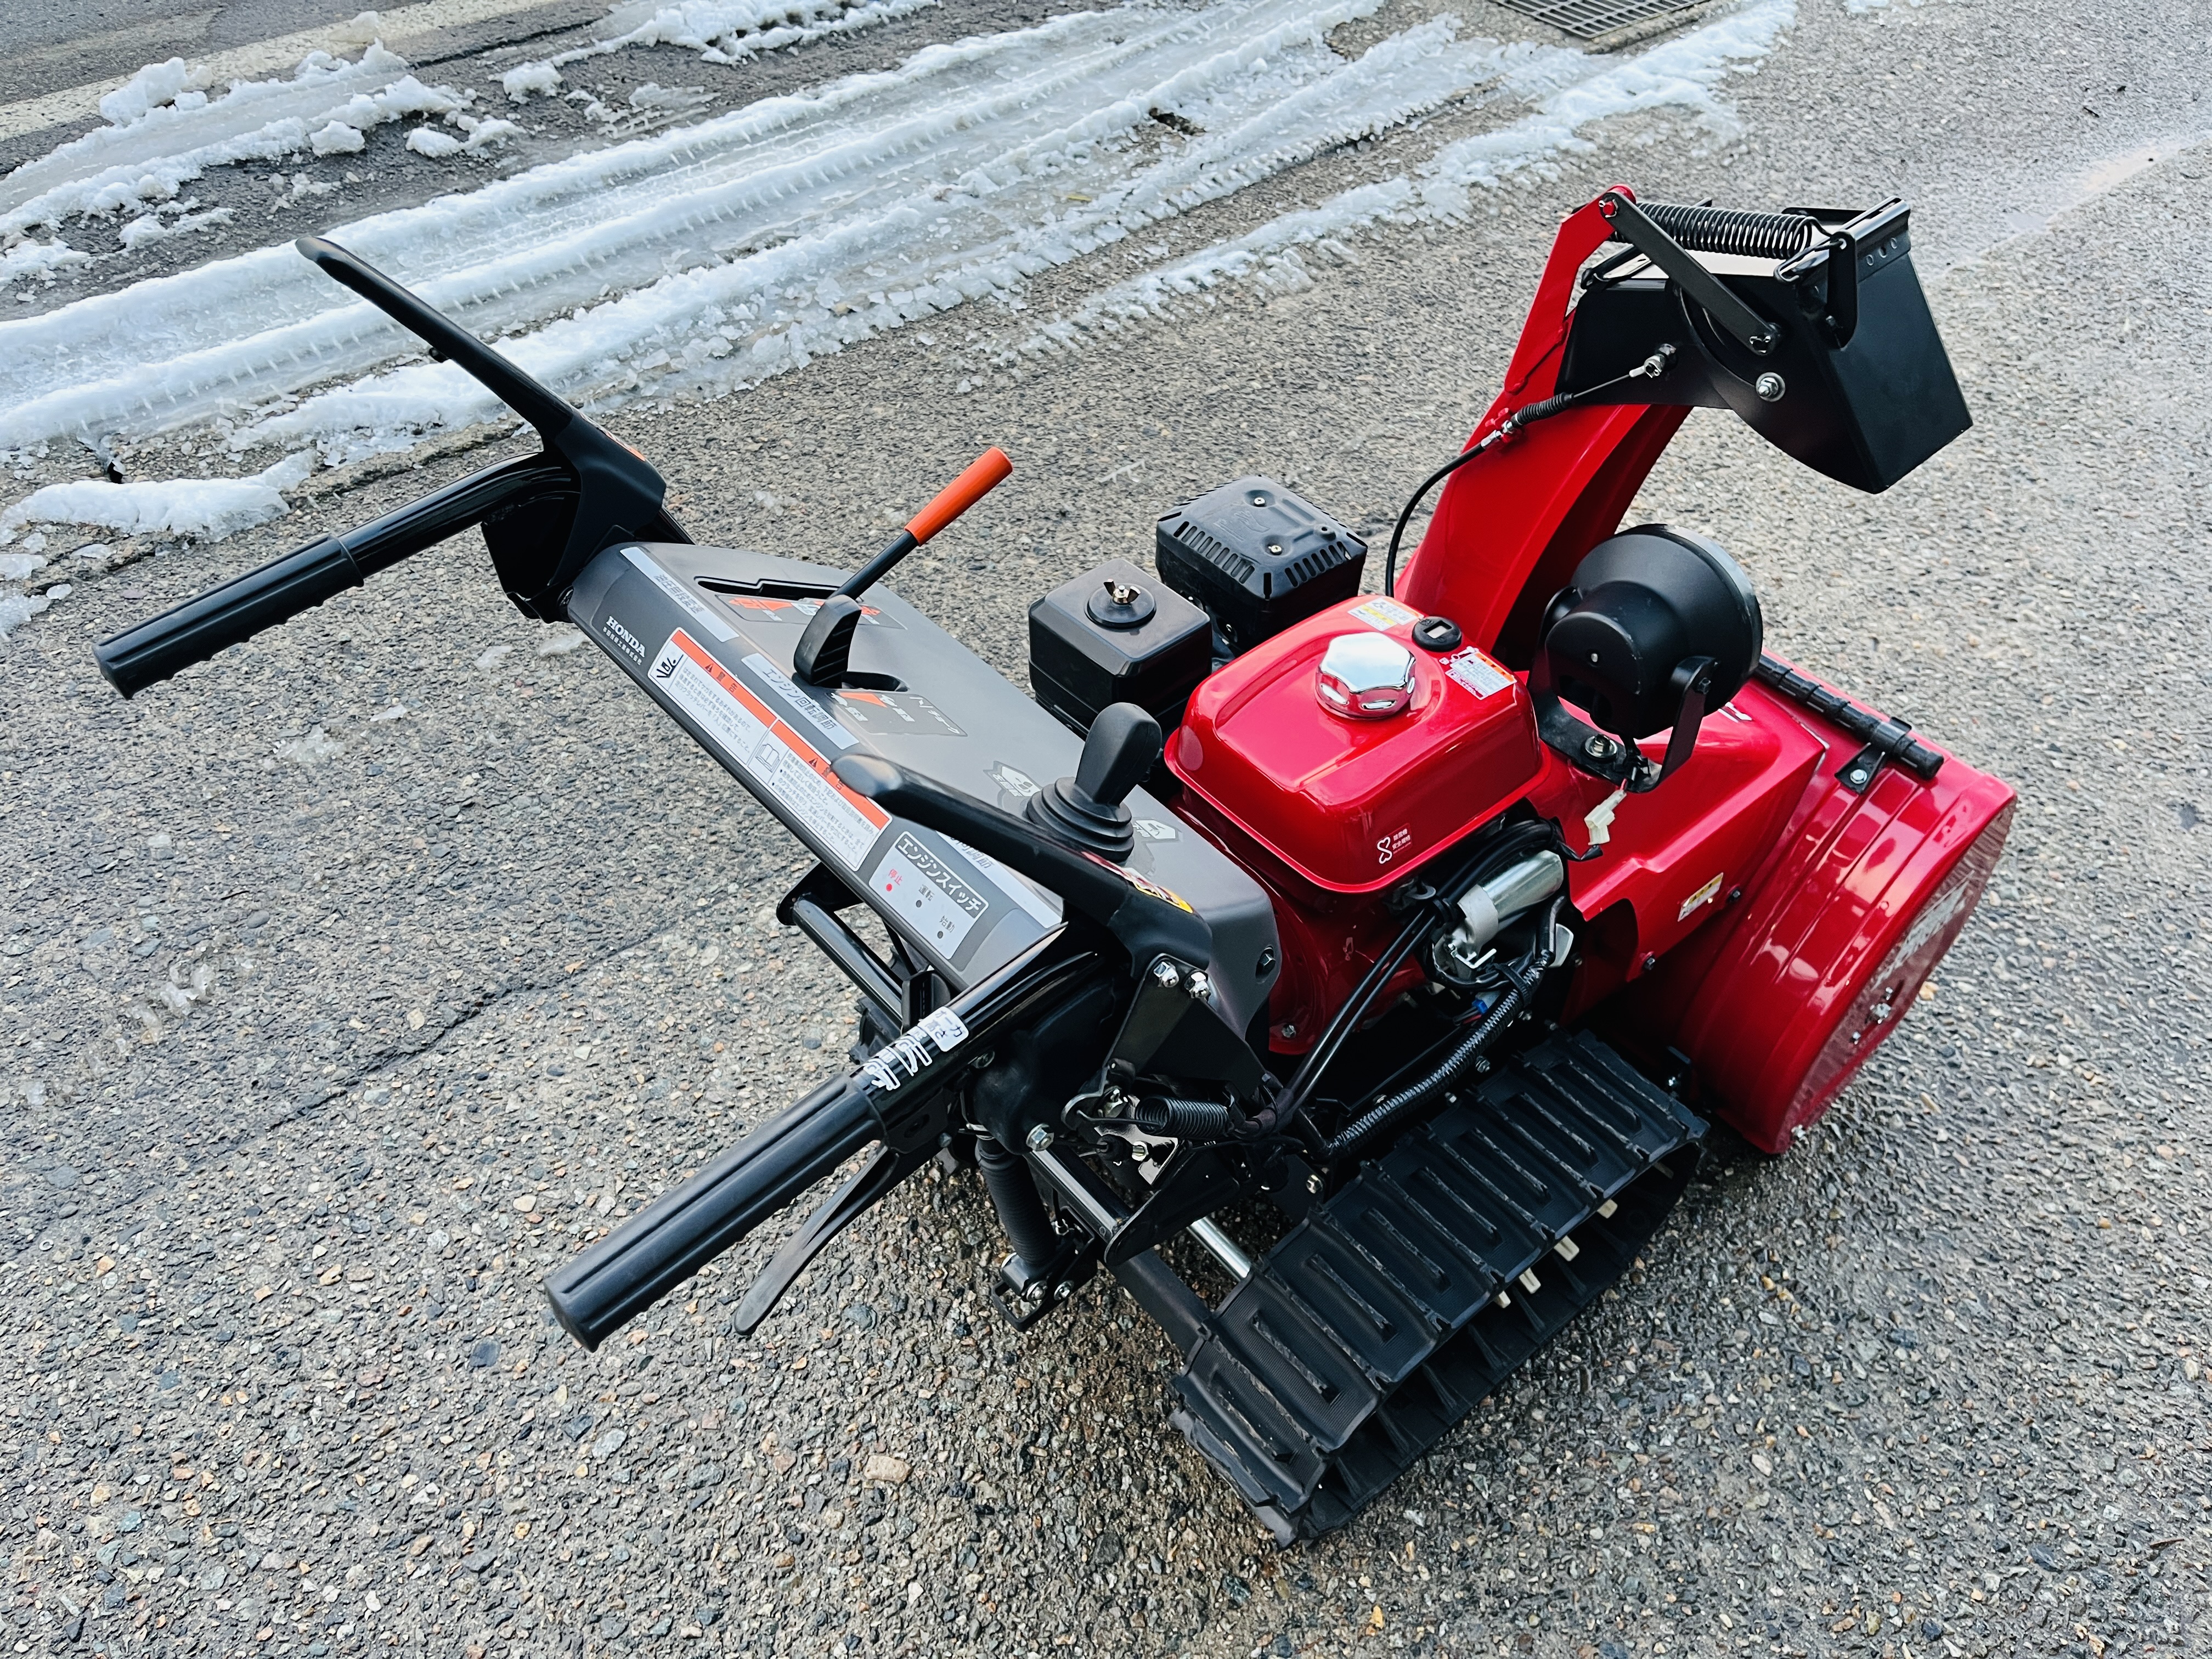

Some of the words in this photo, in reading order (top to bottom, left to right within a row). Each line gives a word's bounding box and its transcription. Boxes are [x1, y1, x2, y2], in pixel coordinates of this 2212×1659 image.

[605, 616, 645, 658] HONDA
[762, 669, 837, 730] エンジン回転調節
[928, 710, 960, 734] チョーク
[888, 868, 903, 886] 停止
[898, 838, 982, 911] エンジンスイッチ
[918, 884, 935, 901] 運転
[939, 915, 955, 933] 始動
